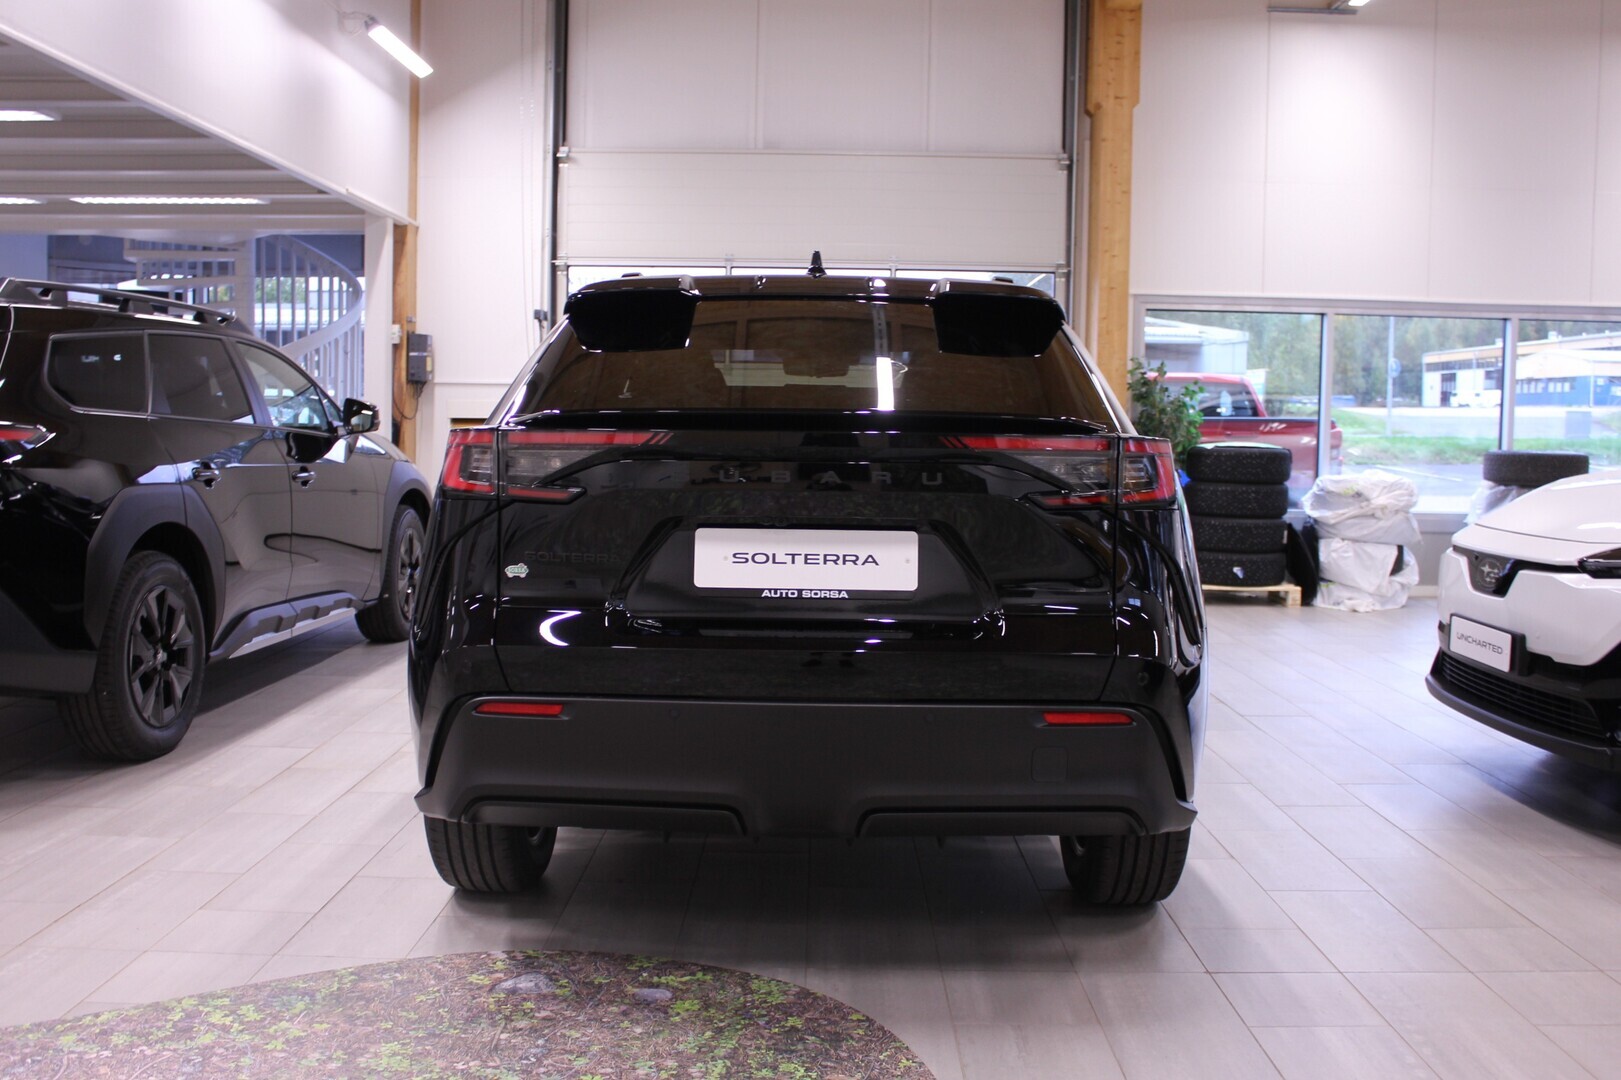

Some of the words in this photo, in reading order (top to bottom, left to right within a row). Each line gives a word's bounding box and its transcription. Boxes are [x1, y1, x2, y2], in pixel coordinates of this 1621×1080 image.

[671, 469, 943, 483] UBARU
[523, 550, 622, 563] SOLTERRA
[731, 552, 880, 566] SOLTERRA
[761, 589, 798, 599] AUTO
[801, 590, 849, 599] SORSA
[1456, 632, 1503, 654] UNCHARTED
